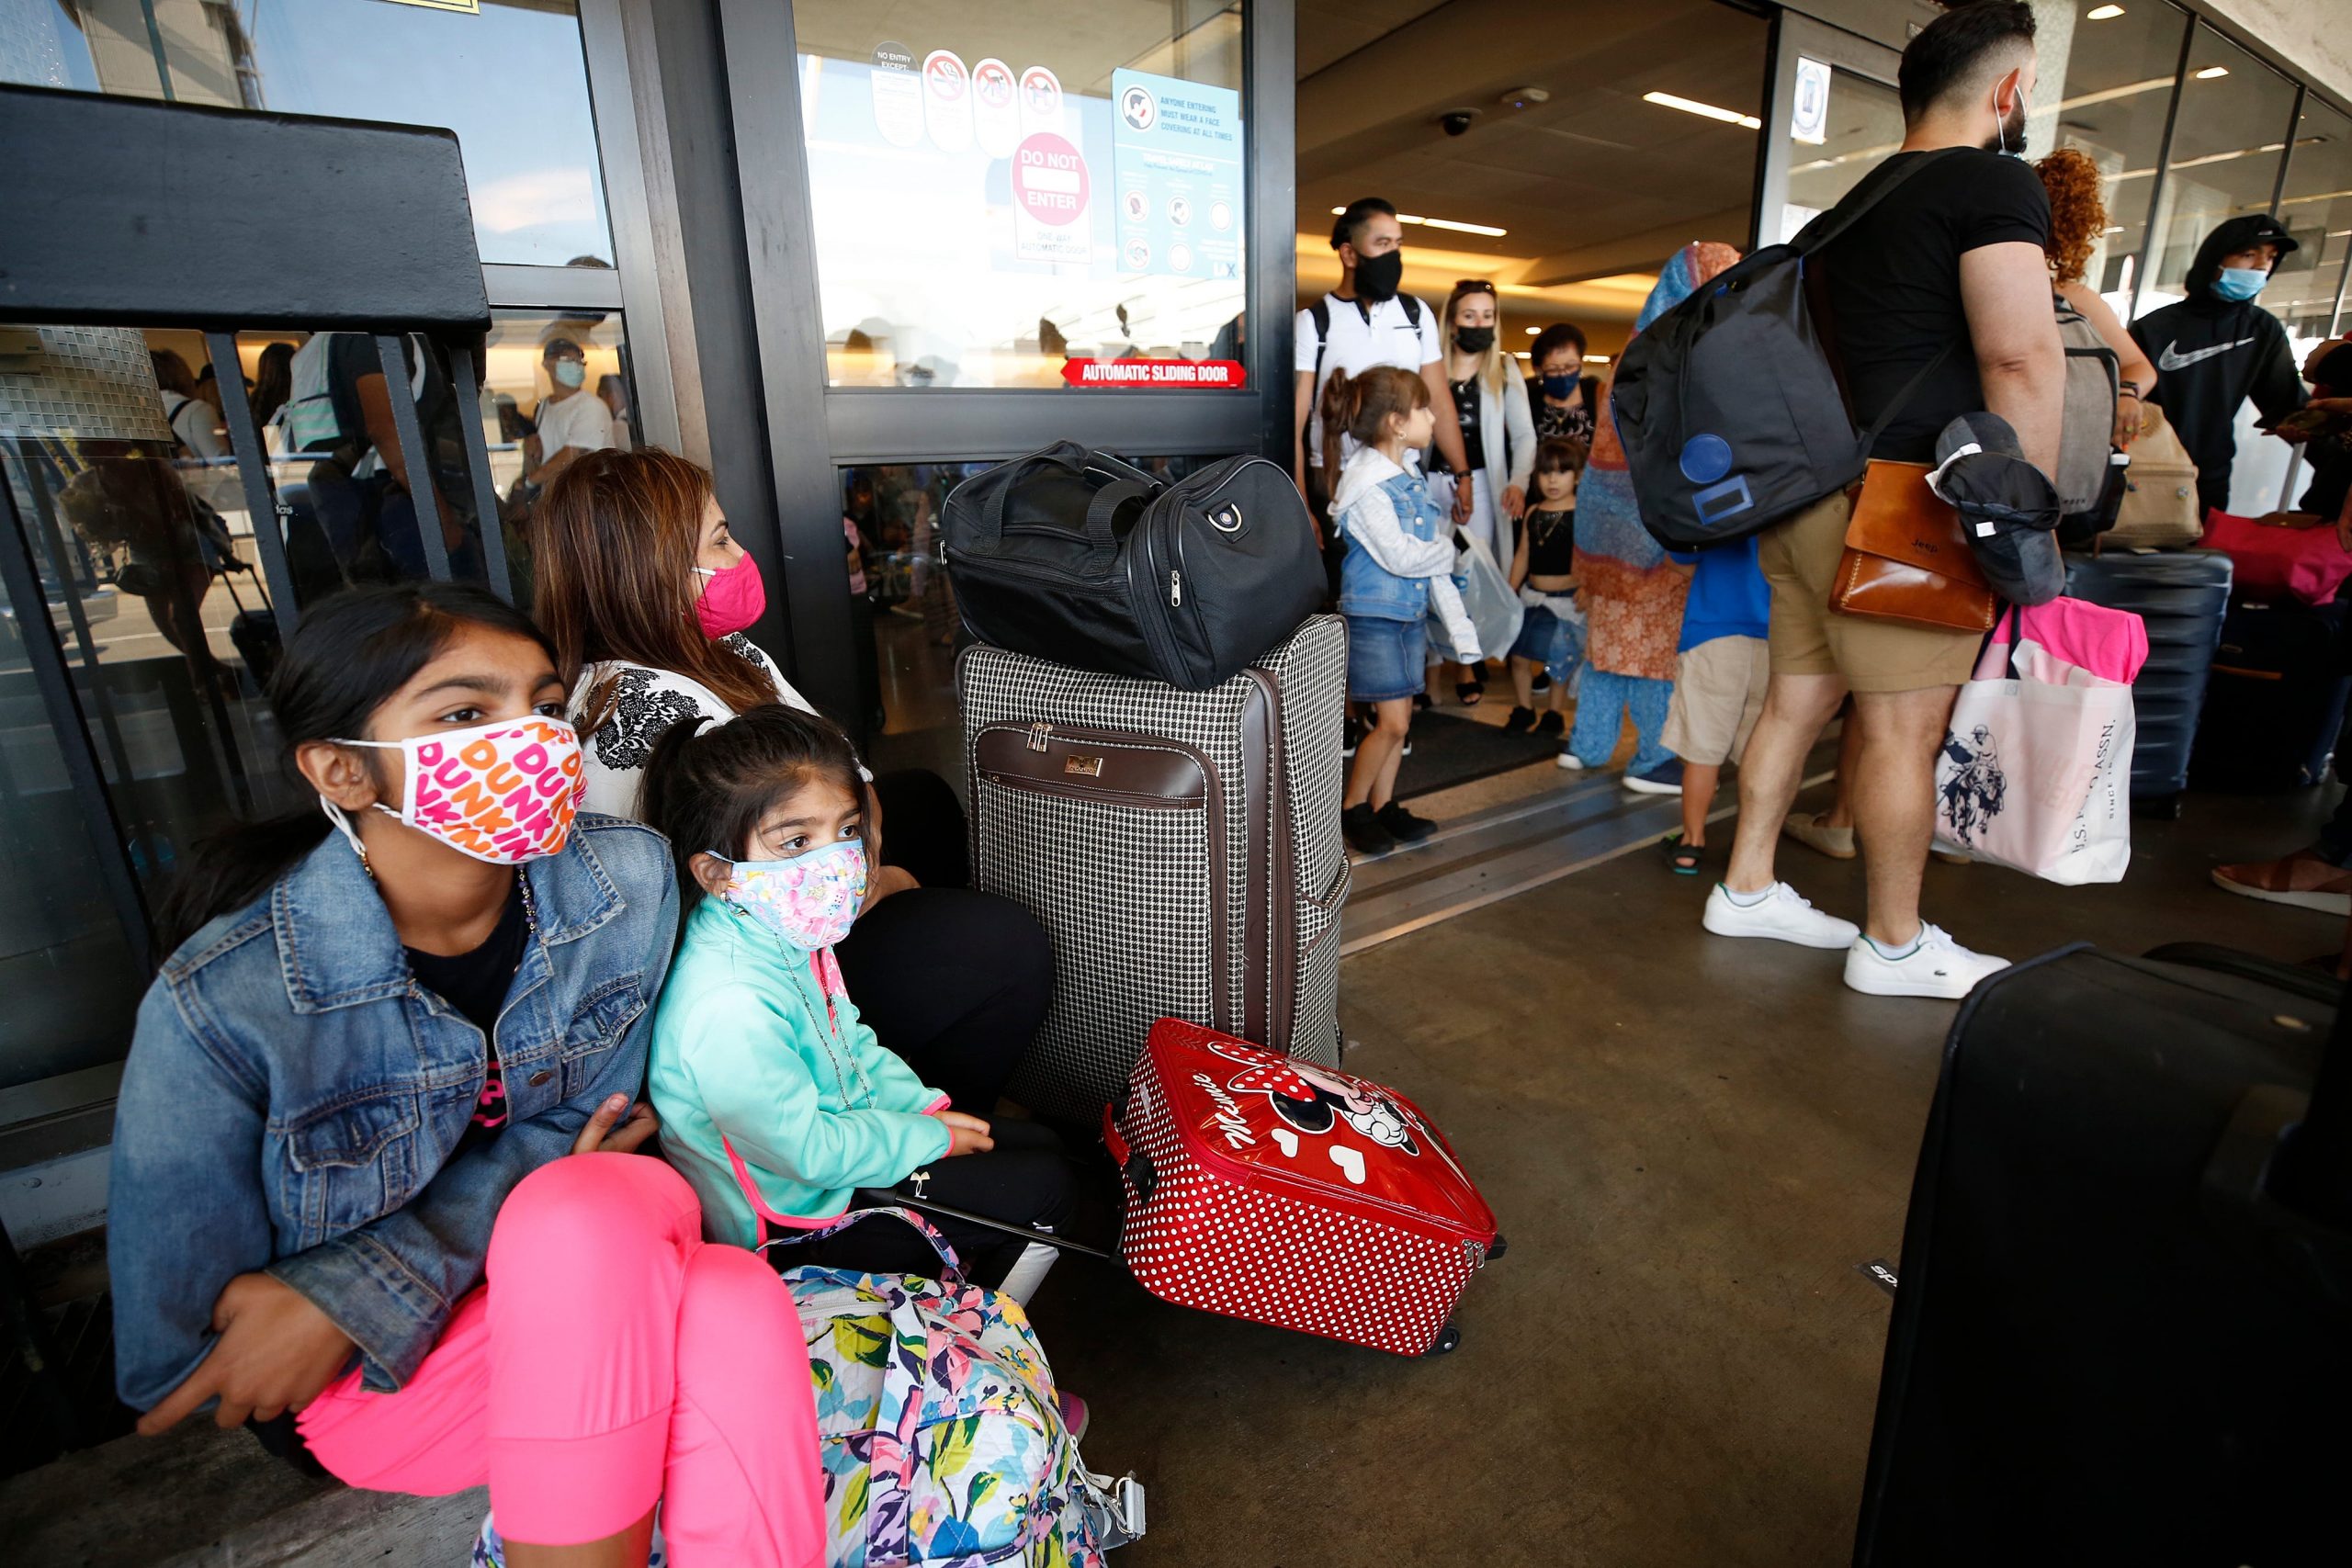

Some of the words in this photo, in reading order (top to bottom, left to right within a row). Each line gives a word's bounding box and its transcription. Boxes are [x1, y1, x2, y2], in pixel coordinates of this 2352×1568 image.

[877, 51, 888, 61] NO
[888, 53, 911, 63] ENTRY
[1160, 96, 1185, 108] ANYONE
[1187, 101, 1216, 114] ENTERING
[1160, 109, 1179, 119] MUST
[1181, 112, 1198, 123] WEAR
[1205, 117, 1220, 127] FACE
[1160, 122, 1192, 135] COVERING
[1193, 128, 1201, 136] AT
[1202, 129, 1213, 138] ALL
[1215, 130, 1233, 141] TIMES
[1021, 149, 1044, 165] DO
[1047, 152, 1079, 170] NOT
[1027, 190, 1077, 209] ENTER
[1082, 364, 1150, 381] AUTOMATIC
[1151, 365, 1195, 381] SLIDING
[1197, 366, 1228, 381] DOOR
[1911, 538, 1938, 553] Jeep
[2095, 719, 2117, 770] ASSN.
[1192, 1072, 1257, 1150] Minnie
